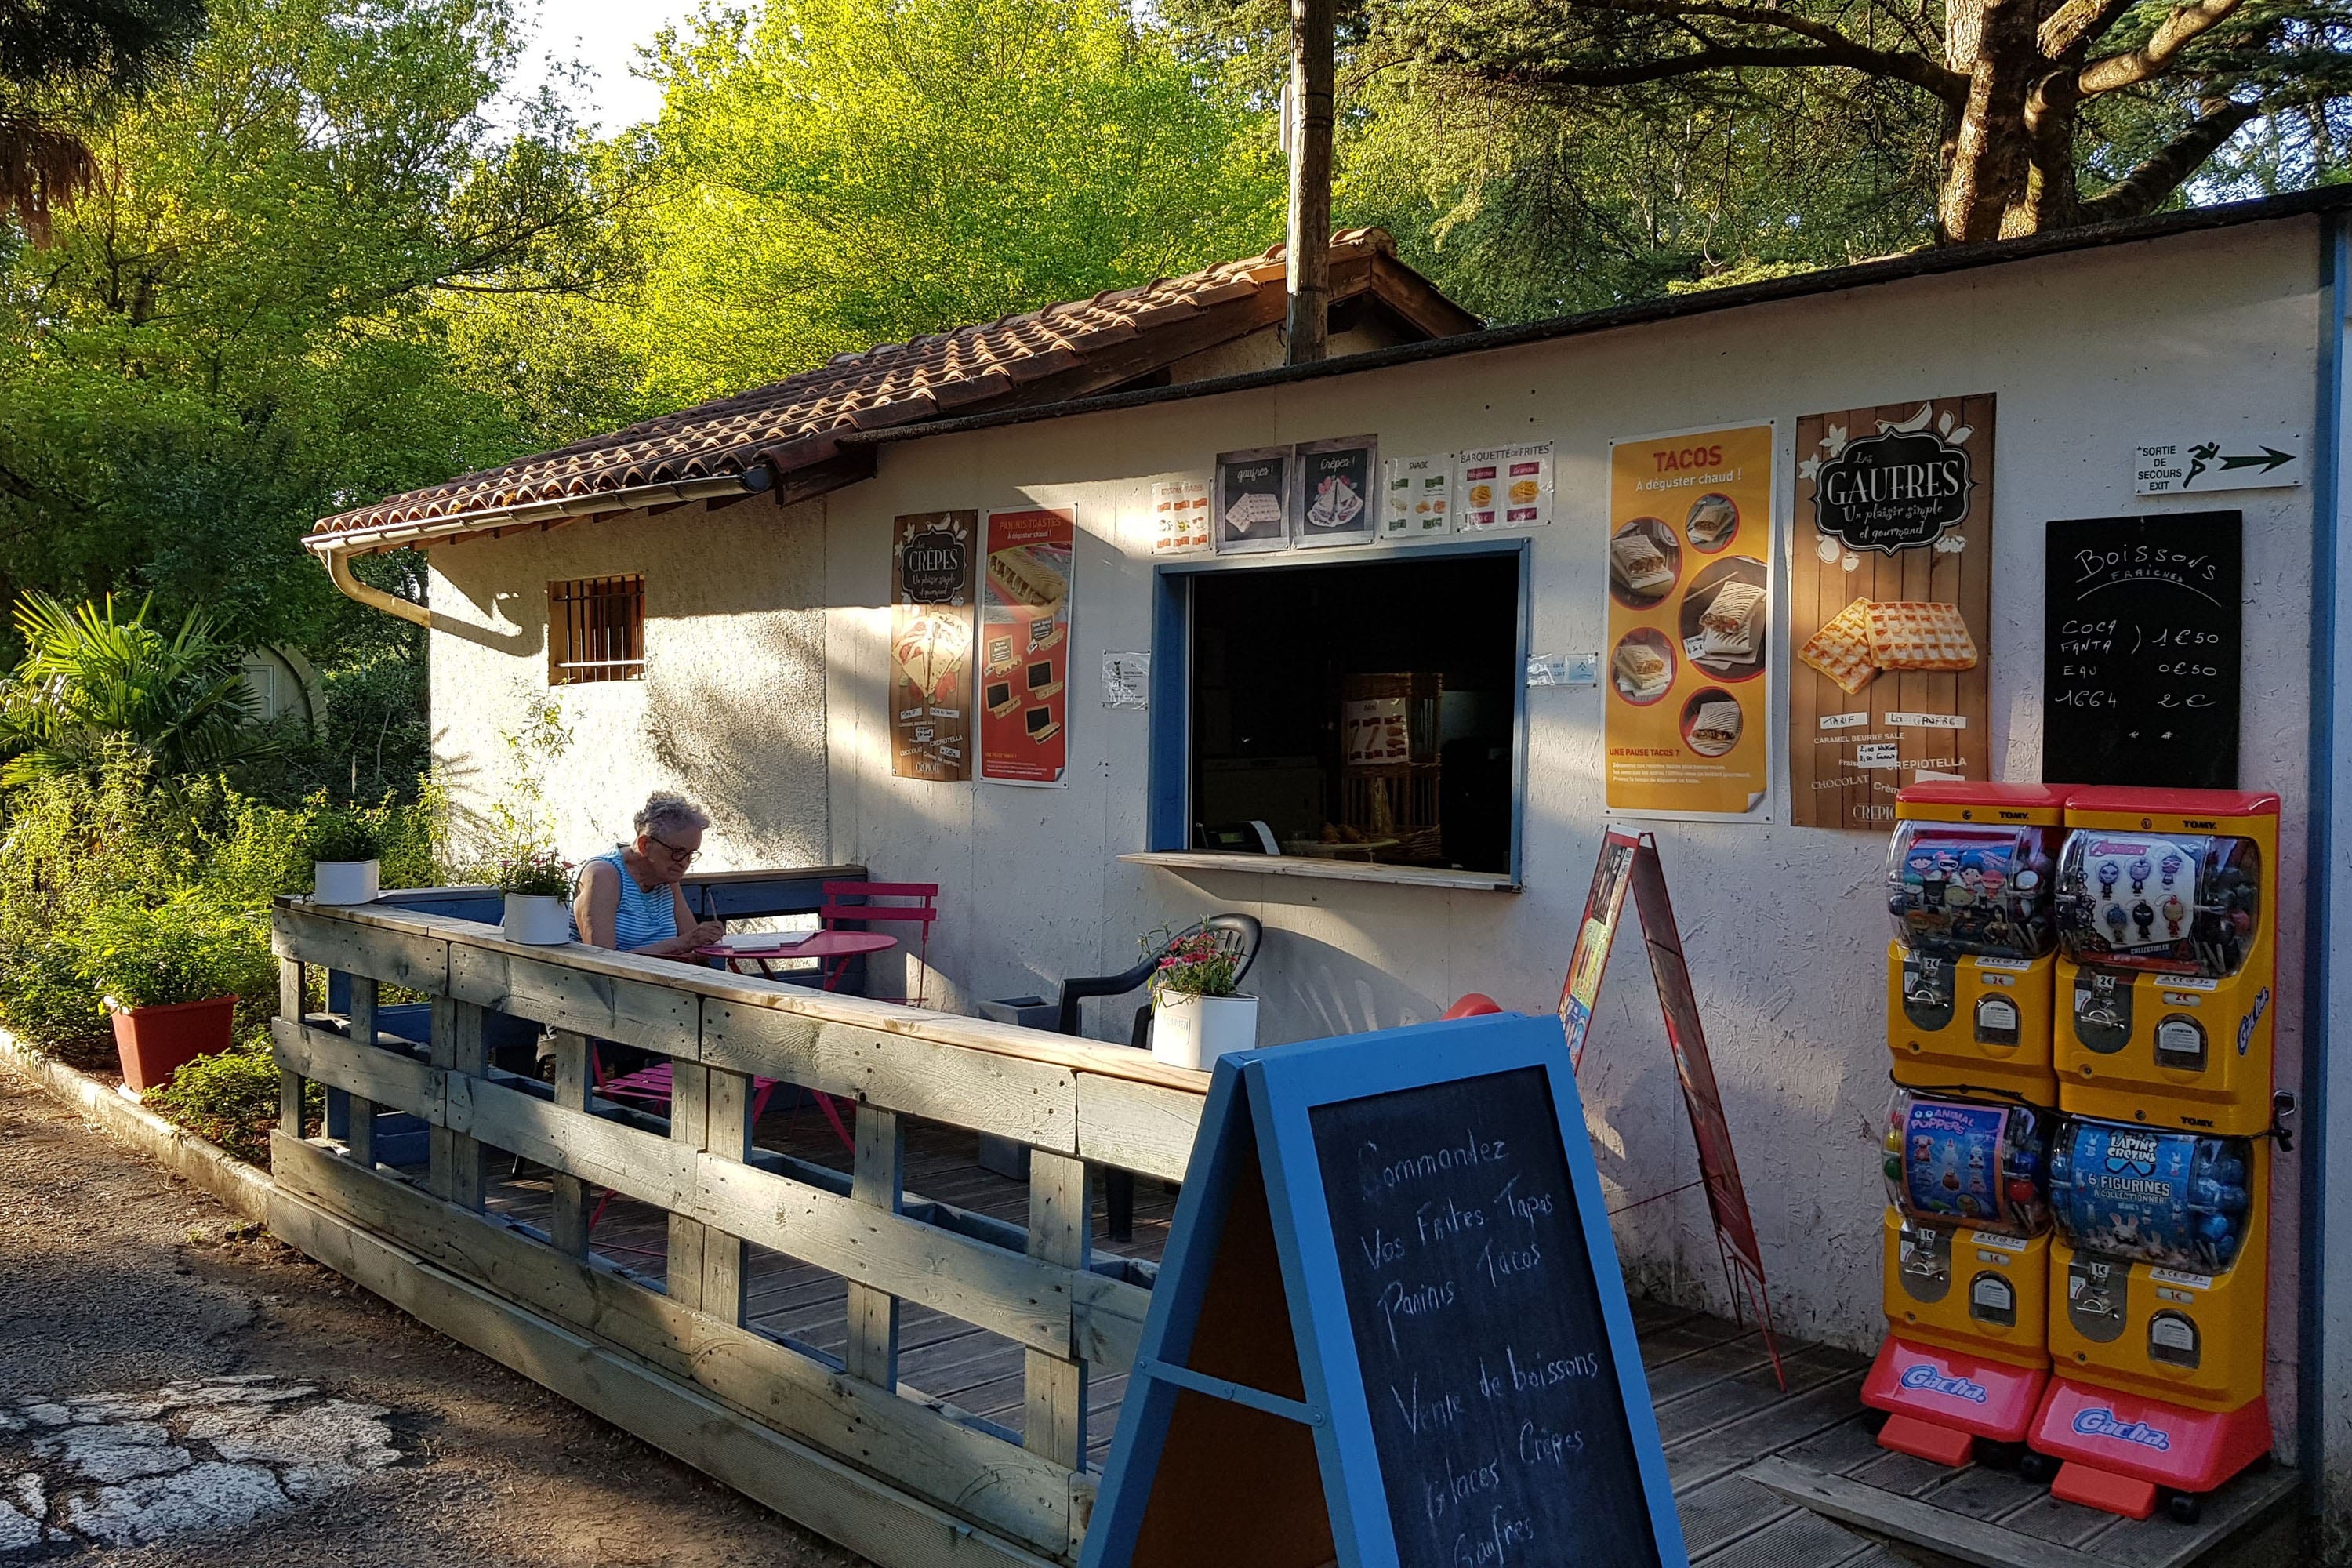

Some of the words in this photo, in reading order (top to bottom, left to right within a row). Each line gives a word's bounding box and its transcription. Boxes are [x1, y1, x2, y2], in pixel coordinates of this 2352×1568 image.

[1461, 449, 1510, 463] BARQUETTE
[1519, 445, 1550, 456] FRITES
[1853, 452, 1873, 464] Les
[2143, 445, 2176, 456] SORTIE
[1653, 445, 1722, 472] TACOS
[2154, 458, 2166, 467] DE
[1635, 479, 1643, 492] À
[1646, 476, 1695, 492] déguster
[1699, 470, 1733, 484] chaud
[1737, 469, 1742, 480] !
[2138, 469, 2182, 480] SECOURS
[1828, 461, 1959, 505] GAUFRES
[2150, 481, 2170, 491] EXIT
[1843, 505, 1862, 521] Un
[1864, 504, 1904, 524] plaisir
[1905, 499, 1943, 523] simple
[1000, 520, 1027, 530] PANINIS
[1860, 528, 1868, 539] et
[1871, 521, 1924, 543] gourmand
[2062, 620, 2117, 635] COCA
[2061, 638, 2112, 655] FANTA
[2063, 666, 2096, 679] EAU
[2055, 690, 2117, 708] 1664
[1812, 775, 1870, 790] CHOCOLAT
[1926, 959, 1938, 967] 2€
[1992, 976, 2004, 985] 2€
[2100, 977, 2113, 985] 2€
[2176, 993, 2189, 1001] 2€
[1934, 1109, 1975, 1127] ANIMAL
[2111, 1136, 2158, 1152] LAPINS
[2088, 1173, 2097, 1185] 6
[2101, 1176, 2171, 1197] FIGURINES
[2101, 1190, 2165, 1205] COLLECTIONNER
[1360, 1227, 1406, 1269] Vos
[1417, 1198, 1484, 1246] Frites
[1494, 1174, 1553, 1230] Tapas
[1924, 1230, 1933, 1239] 1€
[2096, 1265, 2105, 1274] 1€
[1377, 1279, 1454, 1359] Paninis
[1476, 1237, 1541, 1287] Tacos
[2170, 1291, 2182, 1301] 1€
[1479, 1356, 1501, 1397] de
[1507, 1345, 1598, 1391] boissons
